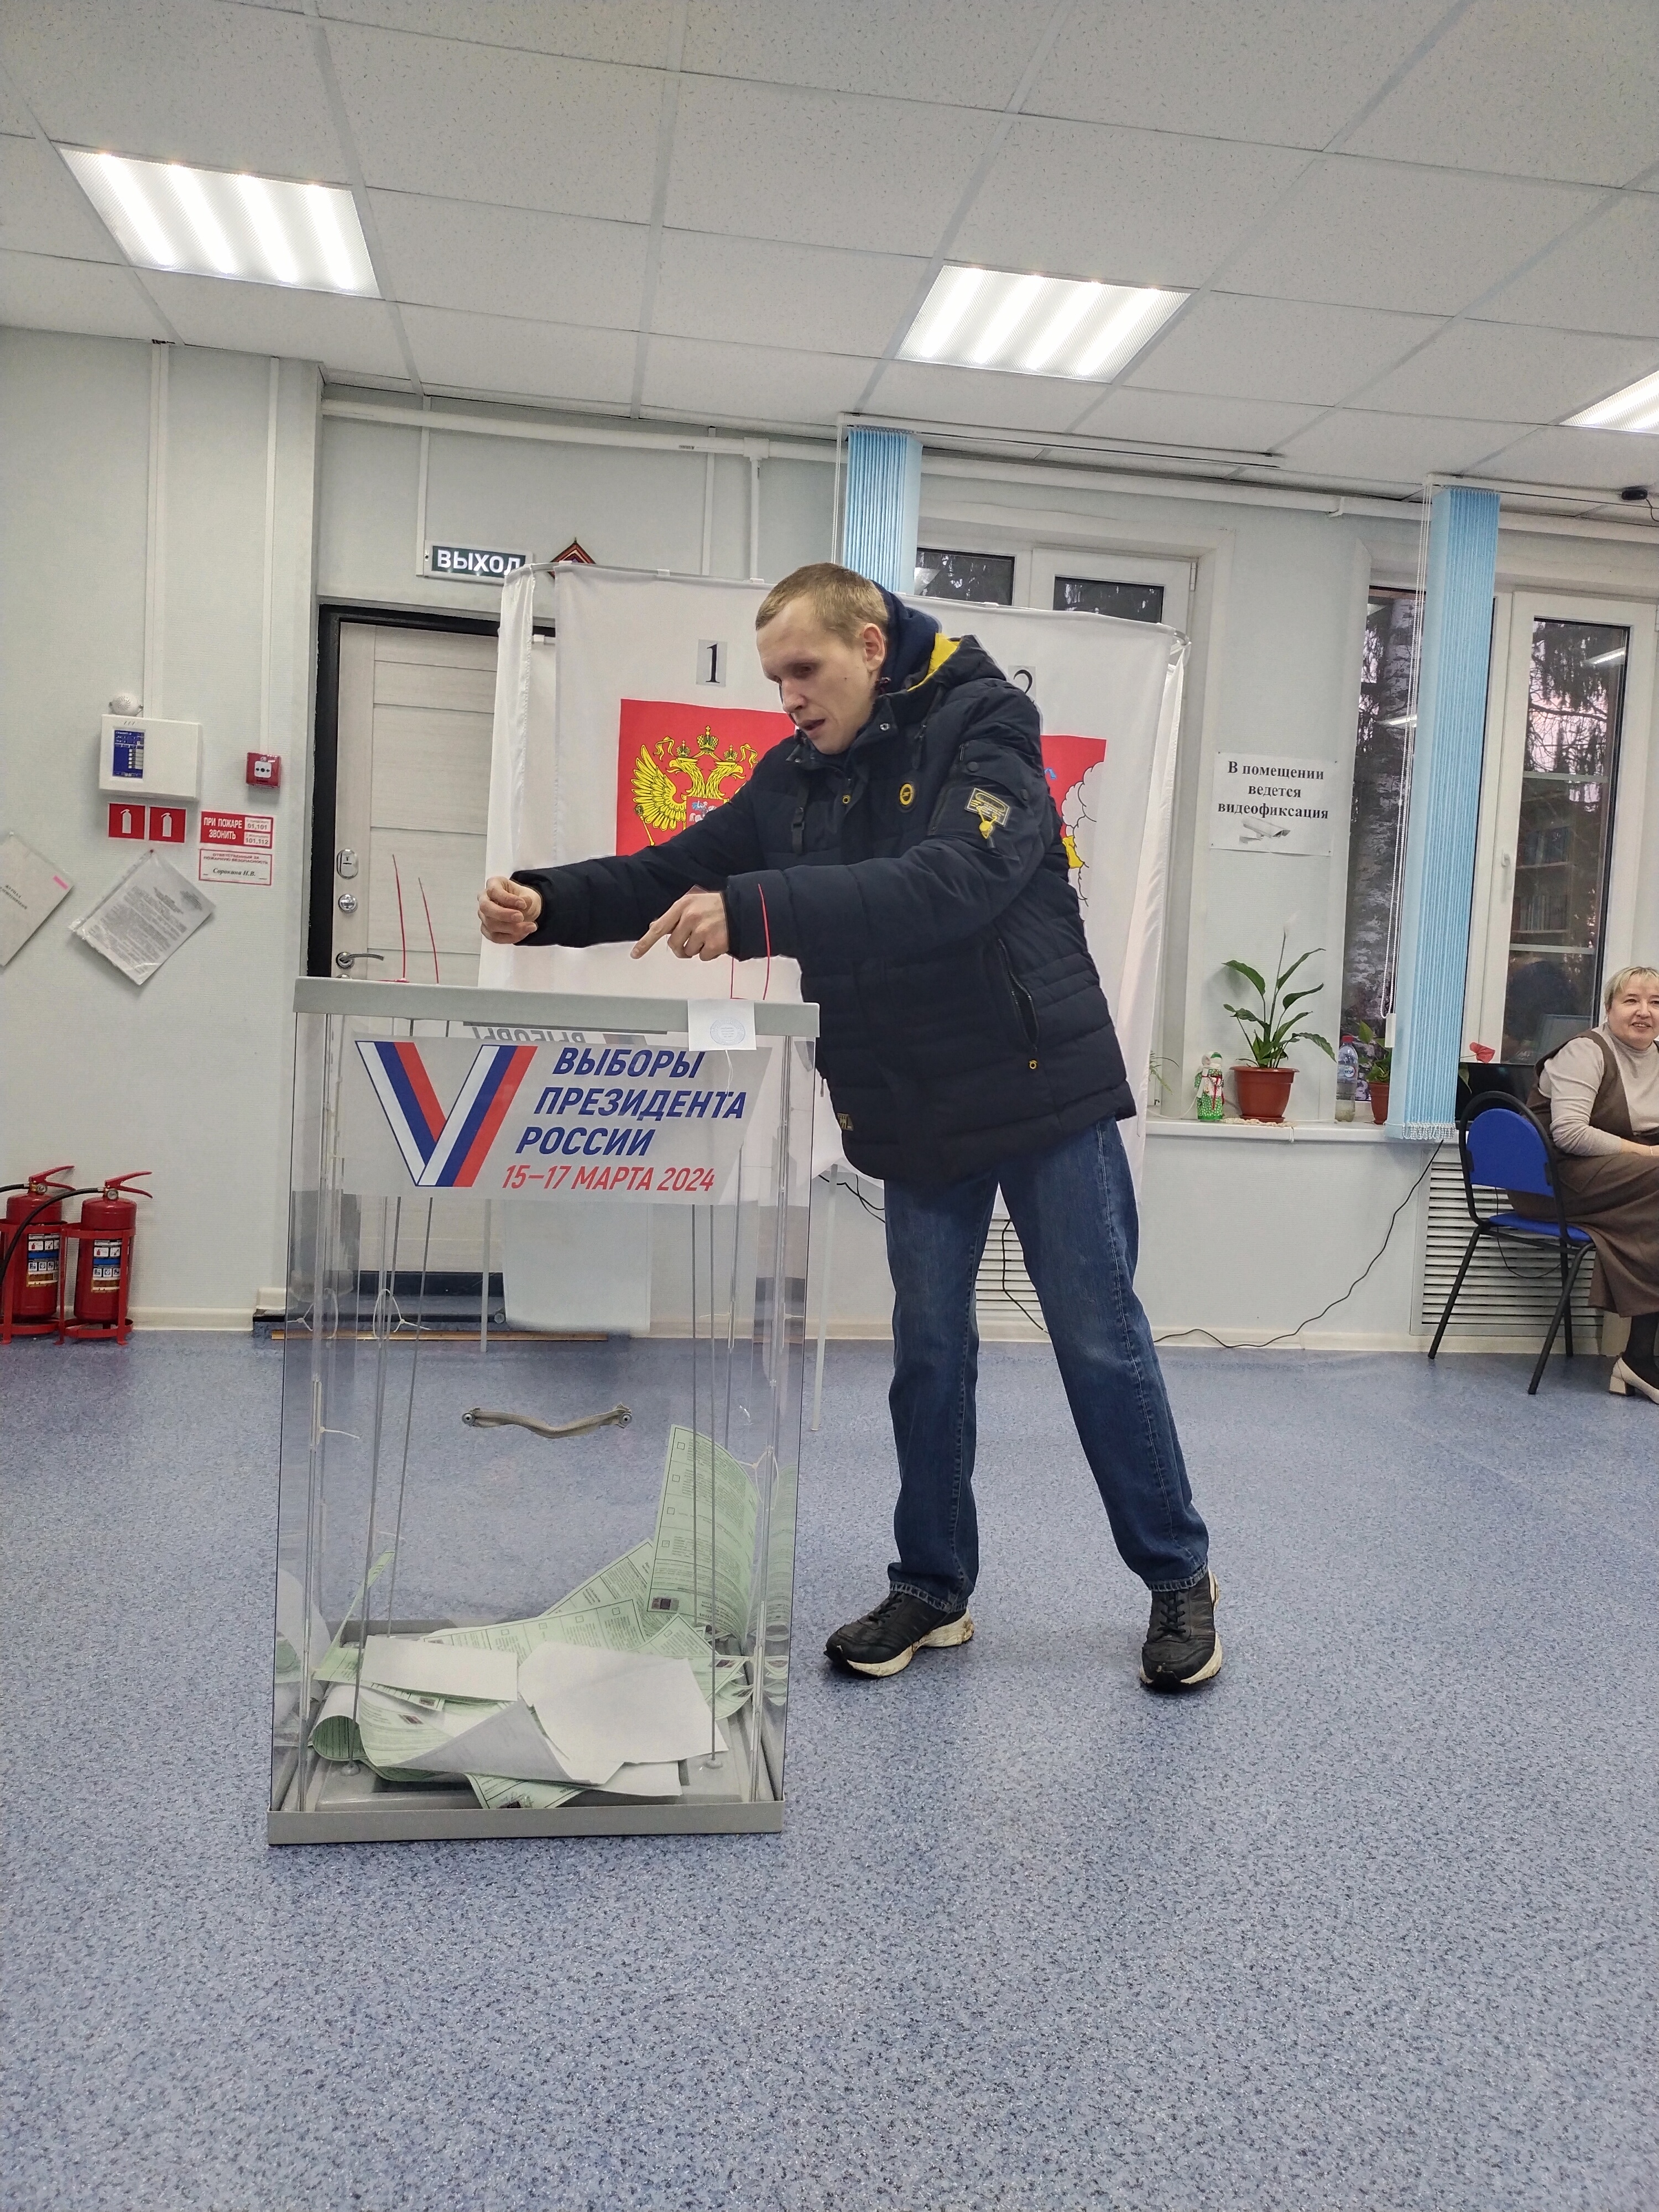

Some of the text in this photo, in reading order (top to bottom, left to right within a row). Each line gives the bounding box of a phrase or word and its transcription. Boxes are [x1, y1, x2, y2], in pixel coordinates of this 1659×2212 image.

[437, 549, 521, 576] ВЫХОД
[705, 643, 721, 684] 1
[1227, 760, 1324, 780] В помещении
[1248, 785, 1302, 798] ведется
[204, 817, 216, 826] ПРИ
[218, 818, 243, 829] ПОЖАРЕ
[1218, 802, 1329, 819] видеофиксация
[208, 829, 236, 839] ЗВОНИТЬ
[552, 1047, 706, 1078] ВЫБОРЫ
[534, 1087, 747, 1121] ПРЕЗИДЕНТА
[515, 1126, 656, 1156] РОССИИ
[571, 1165, 655, 1191] МАРТА
[656, 1167, 716, 1192] 2024
